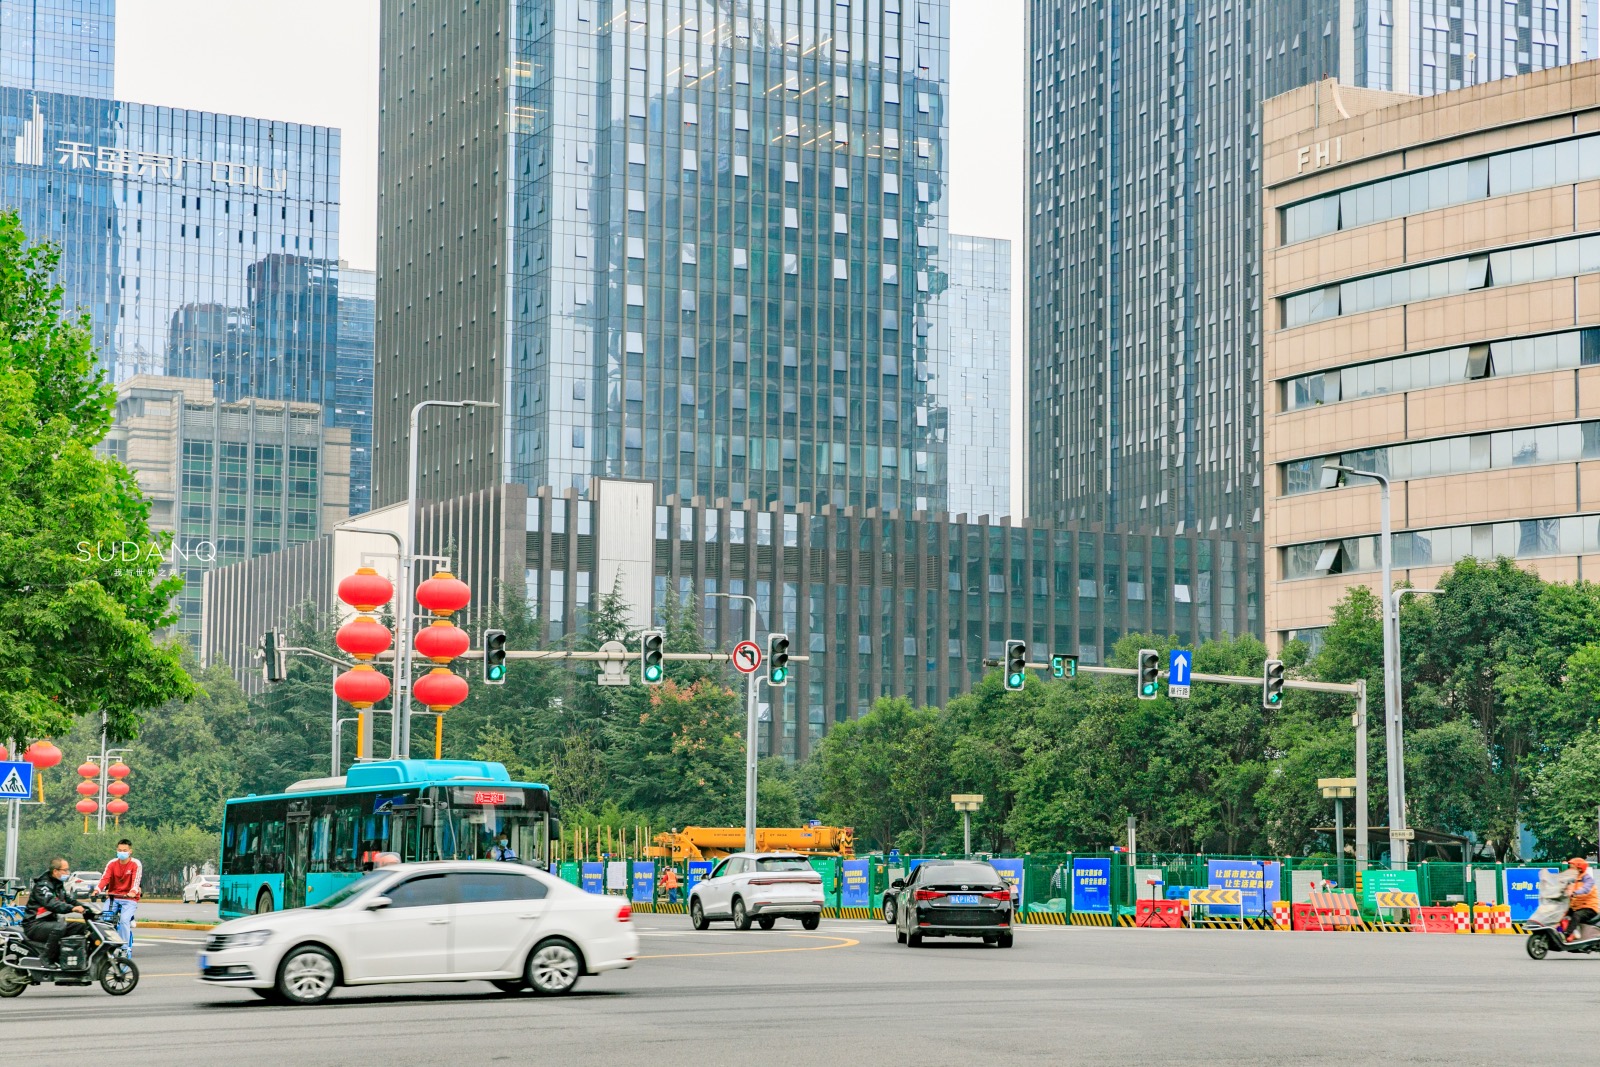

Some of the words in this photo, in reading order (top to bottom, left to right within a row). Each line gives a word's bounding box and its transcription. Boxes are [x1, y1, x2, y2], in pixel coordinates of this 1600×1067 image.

[55, 140, 287, 192] 禾盛京广中心
[1297, 137, 1342, 174] FHI
[1215, 869, 1264, 879] 让城市更文明
[1225, 879, 1274, 889] 让生活更美好
